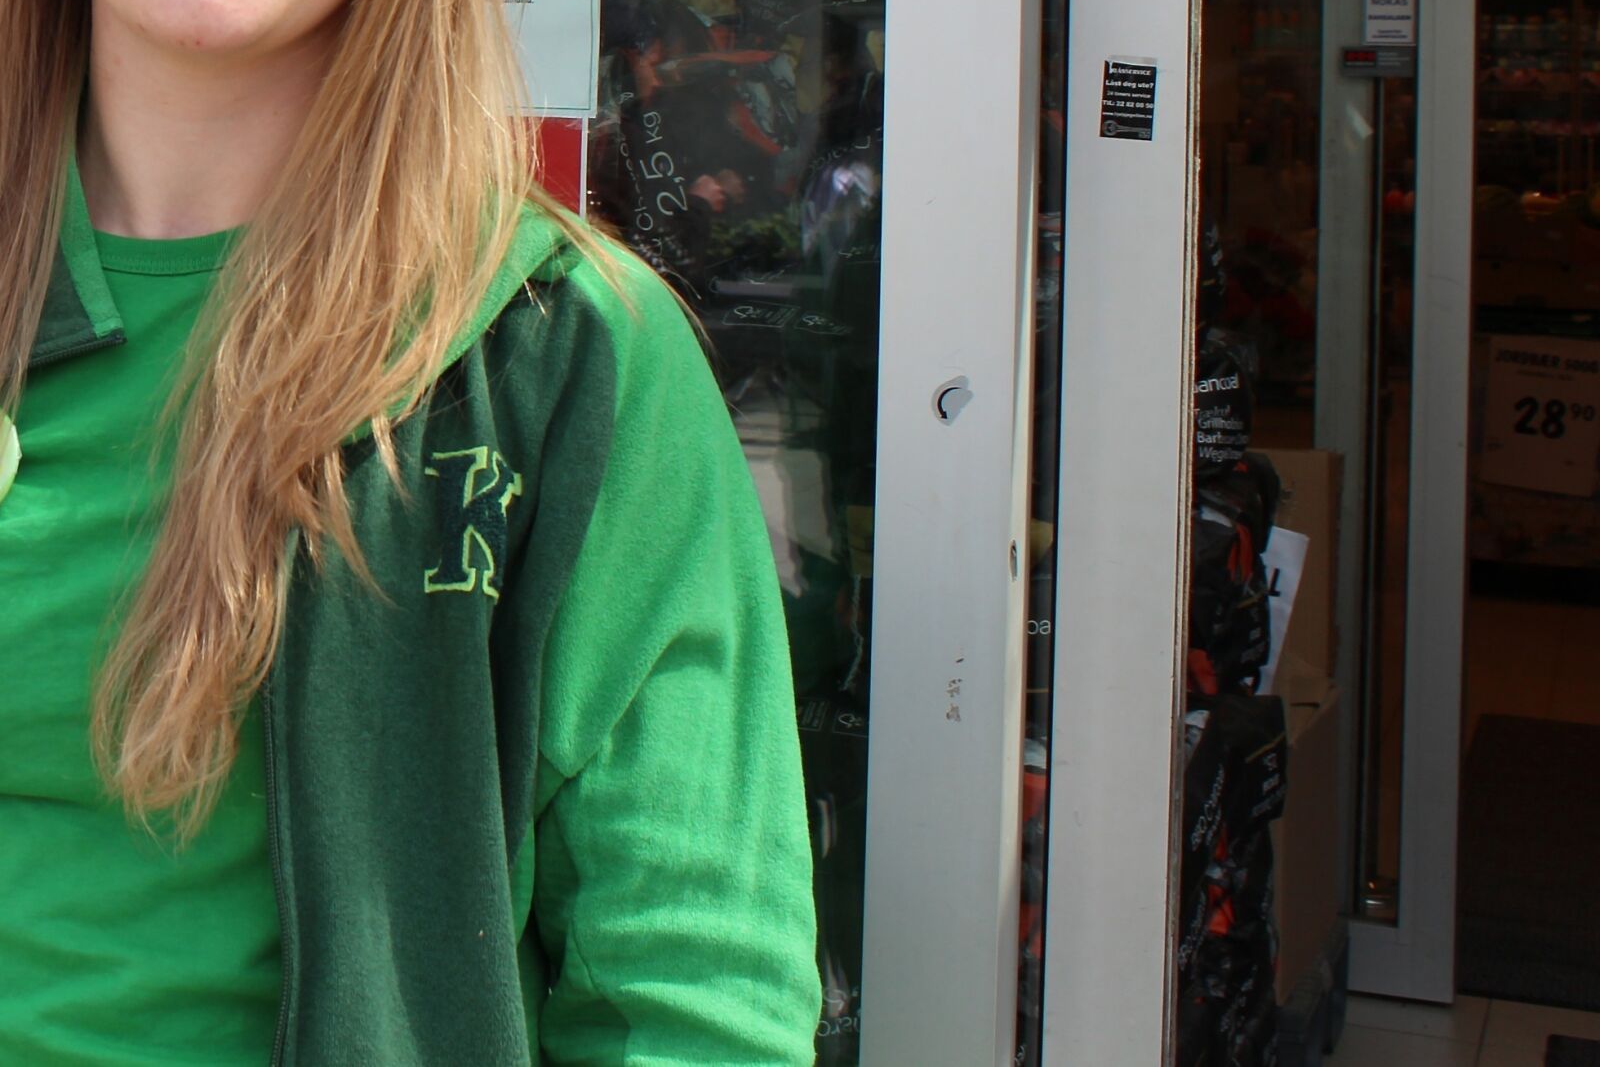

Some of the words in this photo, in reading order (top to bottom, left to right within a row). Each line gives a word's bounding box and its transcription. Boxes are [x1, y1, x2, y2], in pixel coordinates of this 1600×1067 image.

[643, 111, 662, 144] kg
[639, 151, 688, 216] 2,5
[1514, 396, 1567, 439] 28
